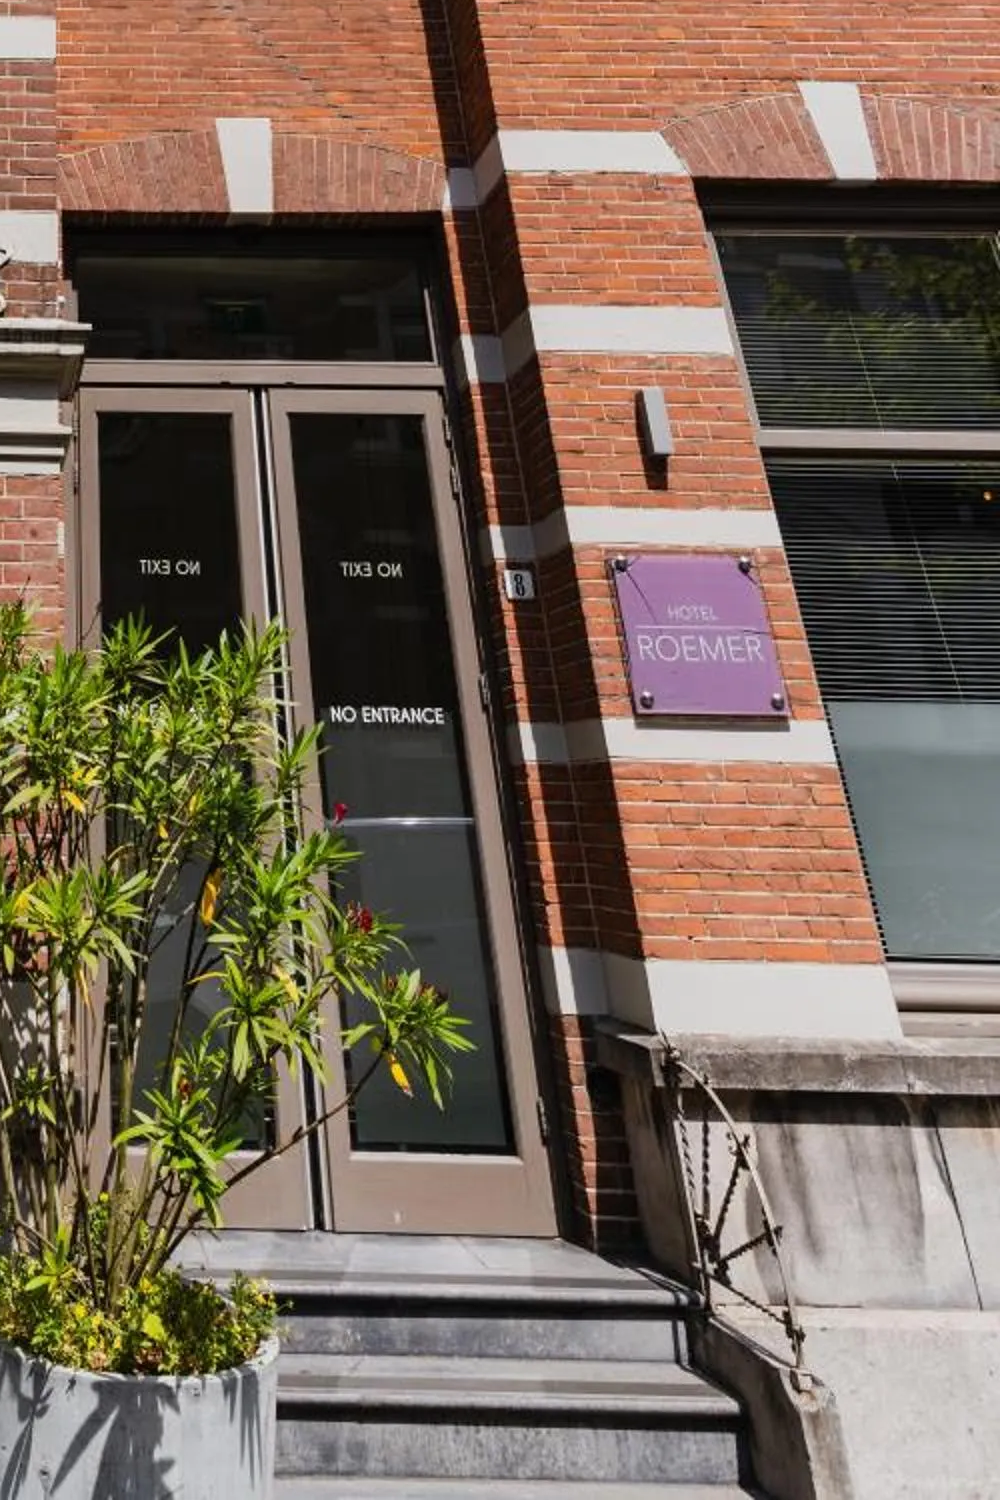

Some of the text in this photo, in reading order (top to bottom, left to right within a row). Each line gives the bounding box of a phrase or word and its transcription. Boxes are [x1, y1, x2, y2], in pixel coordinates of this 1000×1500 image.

[514, 574, 524, 596] 8
[667, 605, 718, 621] HOTEL
[637, 635, 764, 662] ROEMER
[330, 706, 445, 724] NO ENTRANCE
